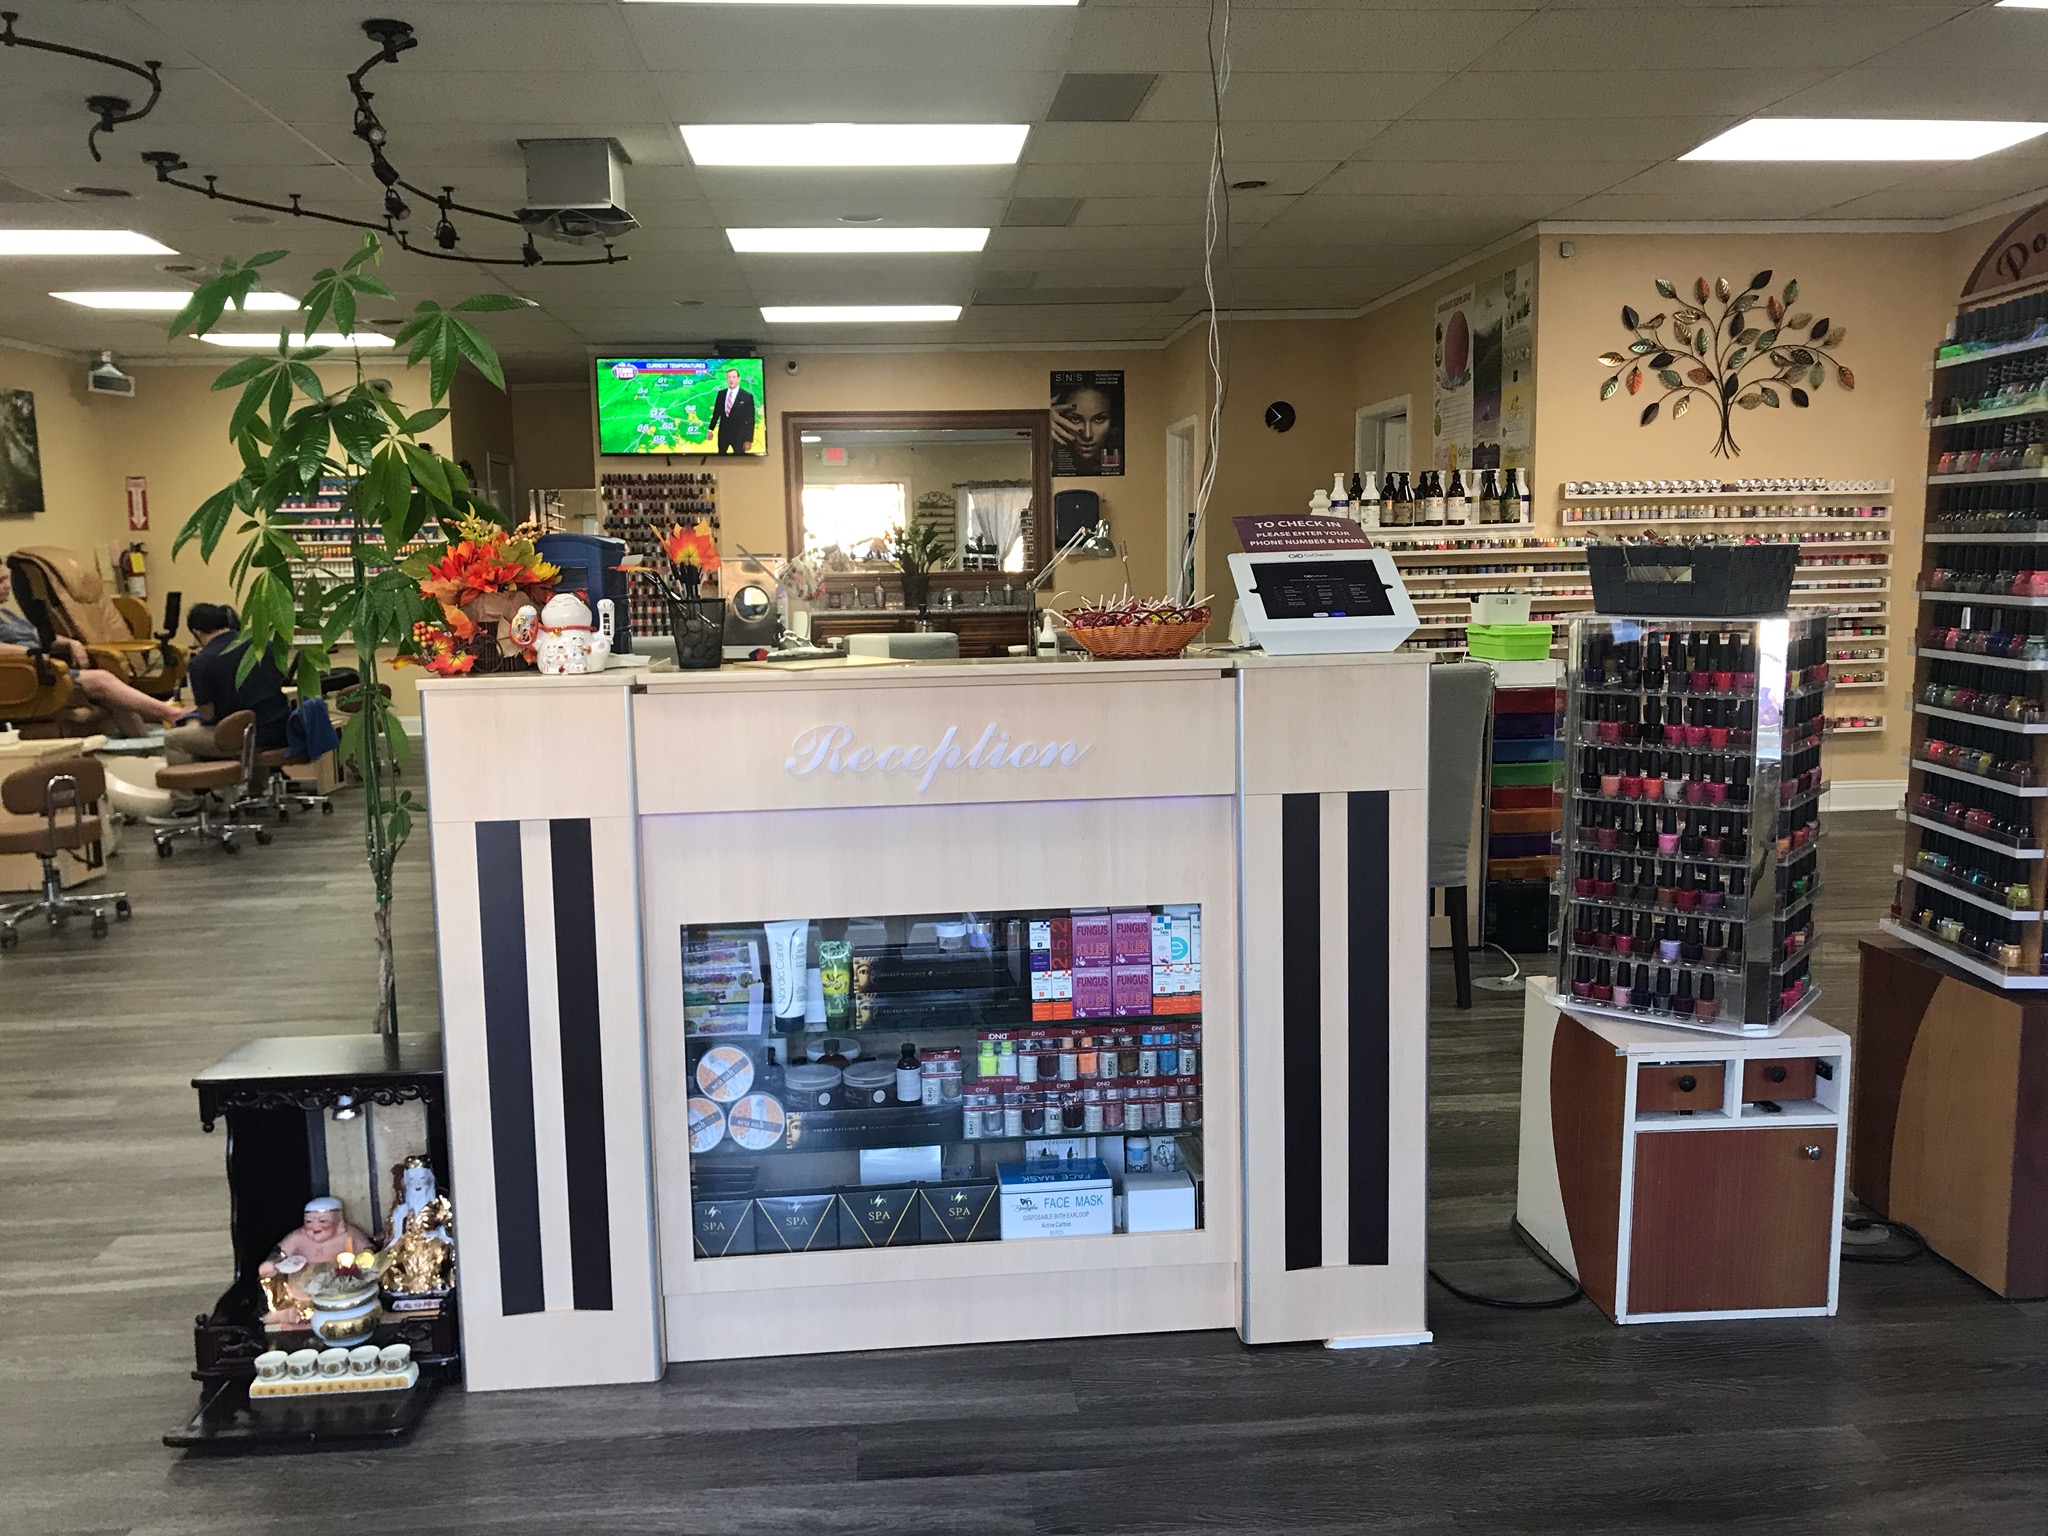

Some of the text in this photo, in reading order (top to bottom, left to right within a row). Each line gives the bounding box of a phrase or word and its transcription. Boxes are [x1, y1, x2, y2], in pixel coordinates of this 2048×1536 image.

[1277, 520, 1323, 528] CHECK
[784, 722, 1093, 793] Reception
[1076, 925, 1108, 935] FUNGUS
[1116, 922, 1148, 933] FUNGUS
[1076, 942, 1110, 956] KILLER
[1116, 940, 1150, 953] KILLER
[1076, 976, 1108, 987] FUNGUS
[1116, 974, 1148, 985] FUNGUS
[778, 970, 786, 1004] Nordic
[1076, 994, 1110, 1007] KILLER
[1116, 991, 1150, 1005] KILLER
[711, 1068, 735, 1090] sea salt
[694, 1120, 707, 1133] salt
[751, 1120, 765, 1129] salt
[1022, 1174, 1055, 1182] MASK
[1044, 1197, 1070, 1208] FACE
[1076, 1195, 1104, 1207] MASK
[868, 1211, 890, 1221] SPA
[948, 1207, 970, 1216] SPA
[1023, 1213, 1053, 1221] DISPOSABLE
[703, 1222, 725, 1231] SPA
[786, 1217, 809, 1226] SPA
